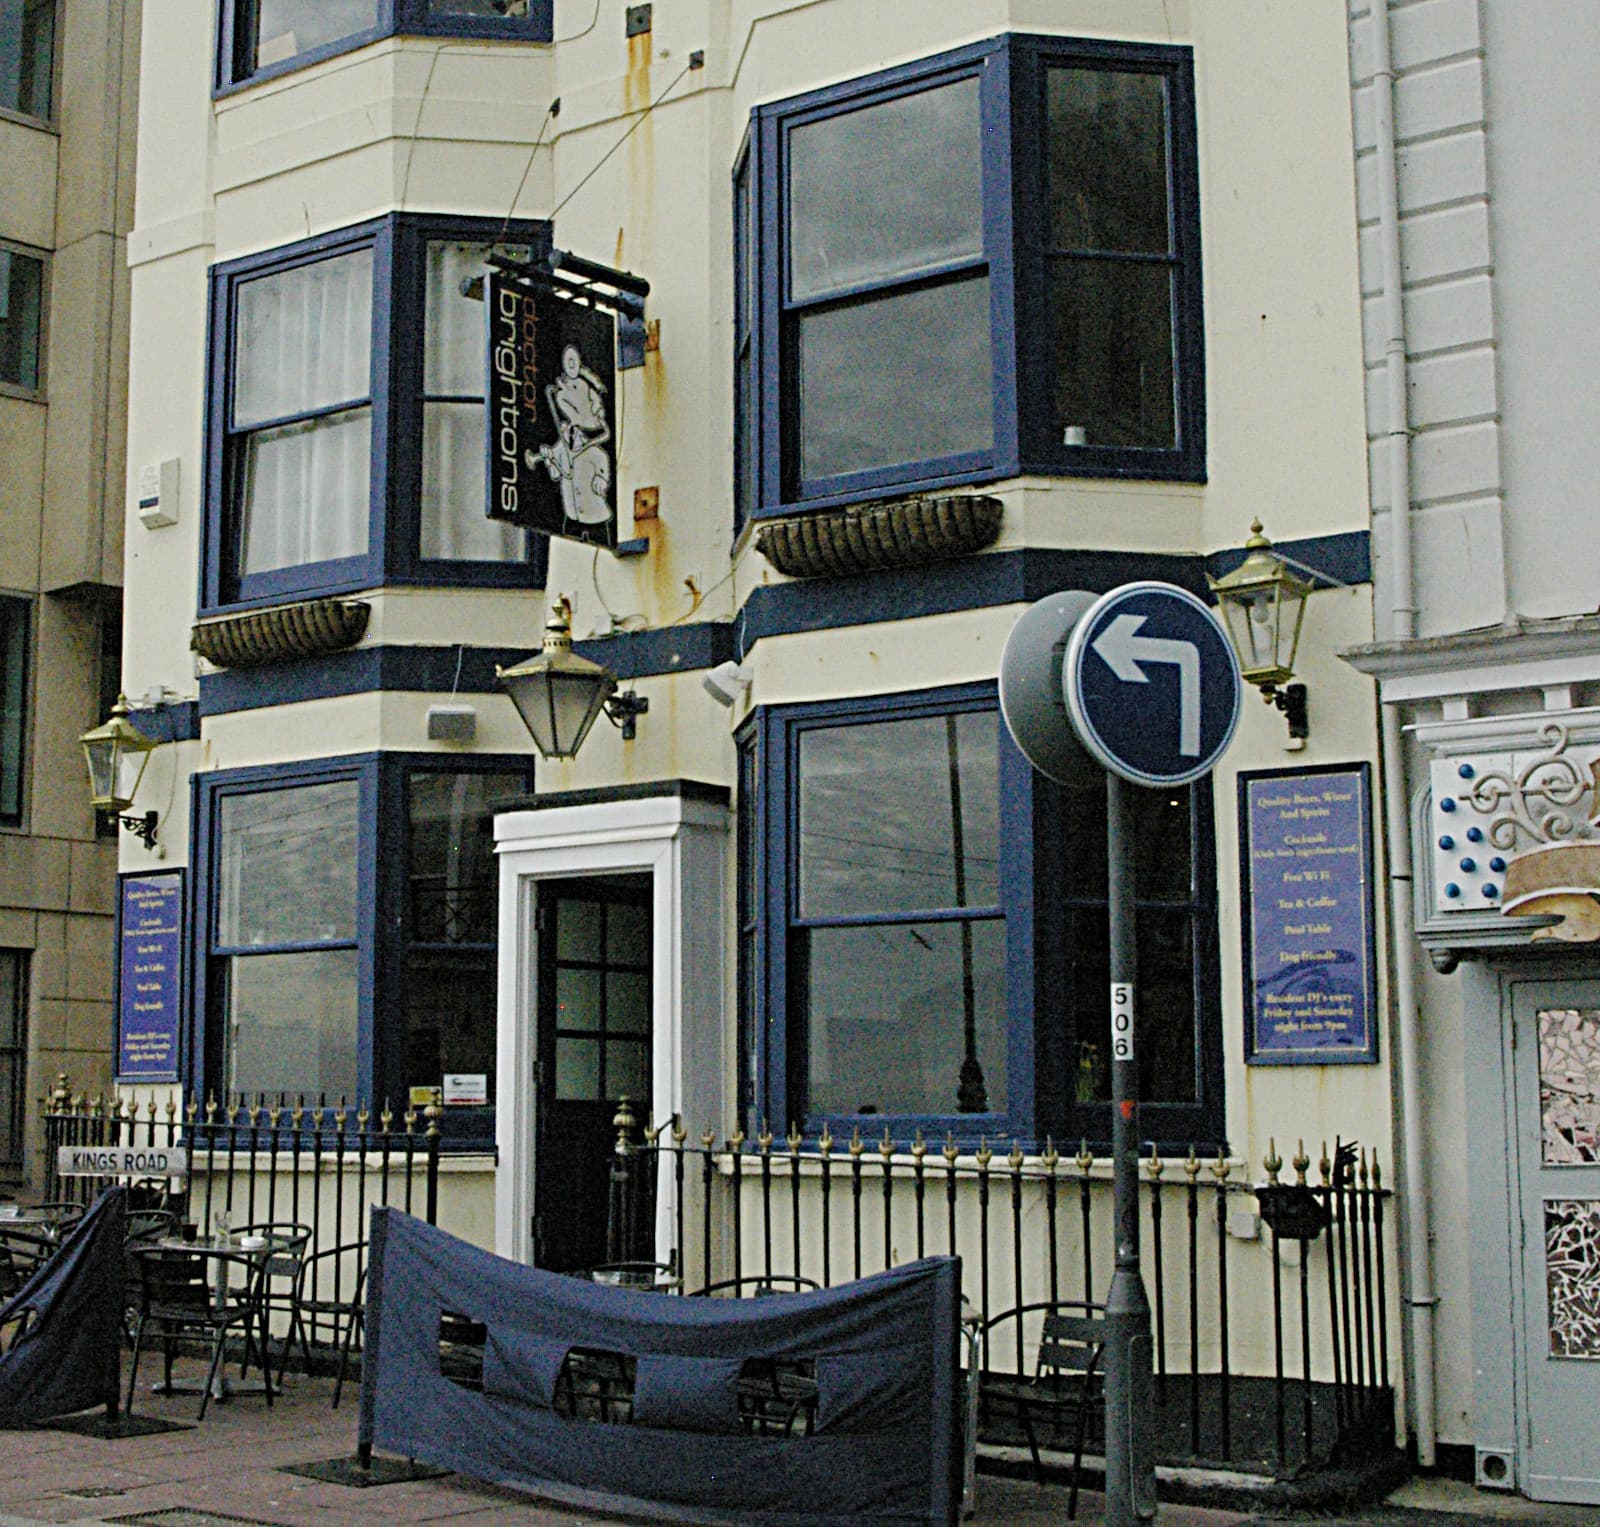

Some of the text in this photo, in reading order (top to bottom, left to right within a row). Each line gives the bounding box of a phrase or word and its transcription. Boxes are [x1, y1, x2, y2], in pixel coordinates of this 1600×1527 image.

[522, 296, 538, 424] doctor
[496, 288, 523, 512] brightons
[1279, 896, 1337, 909] Tea & Coffee
[1280, 951, 1300, 964] Dog
[72, 1153, 168, 1171] KINGS ROAD
